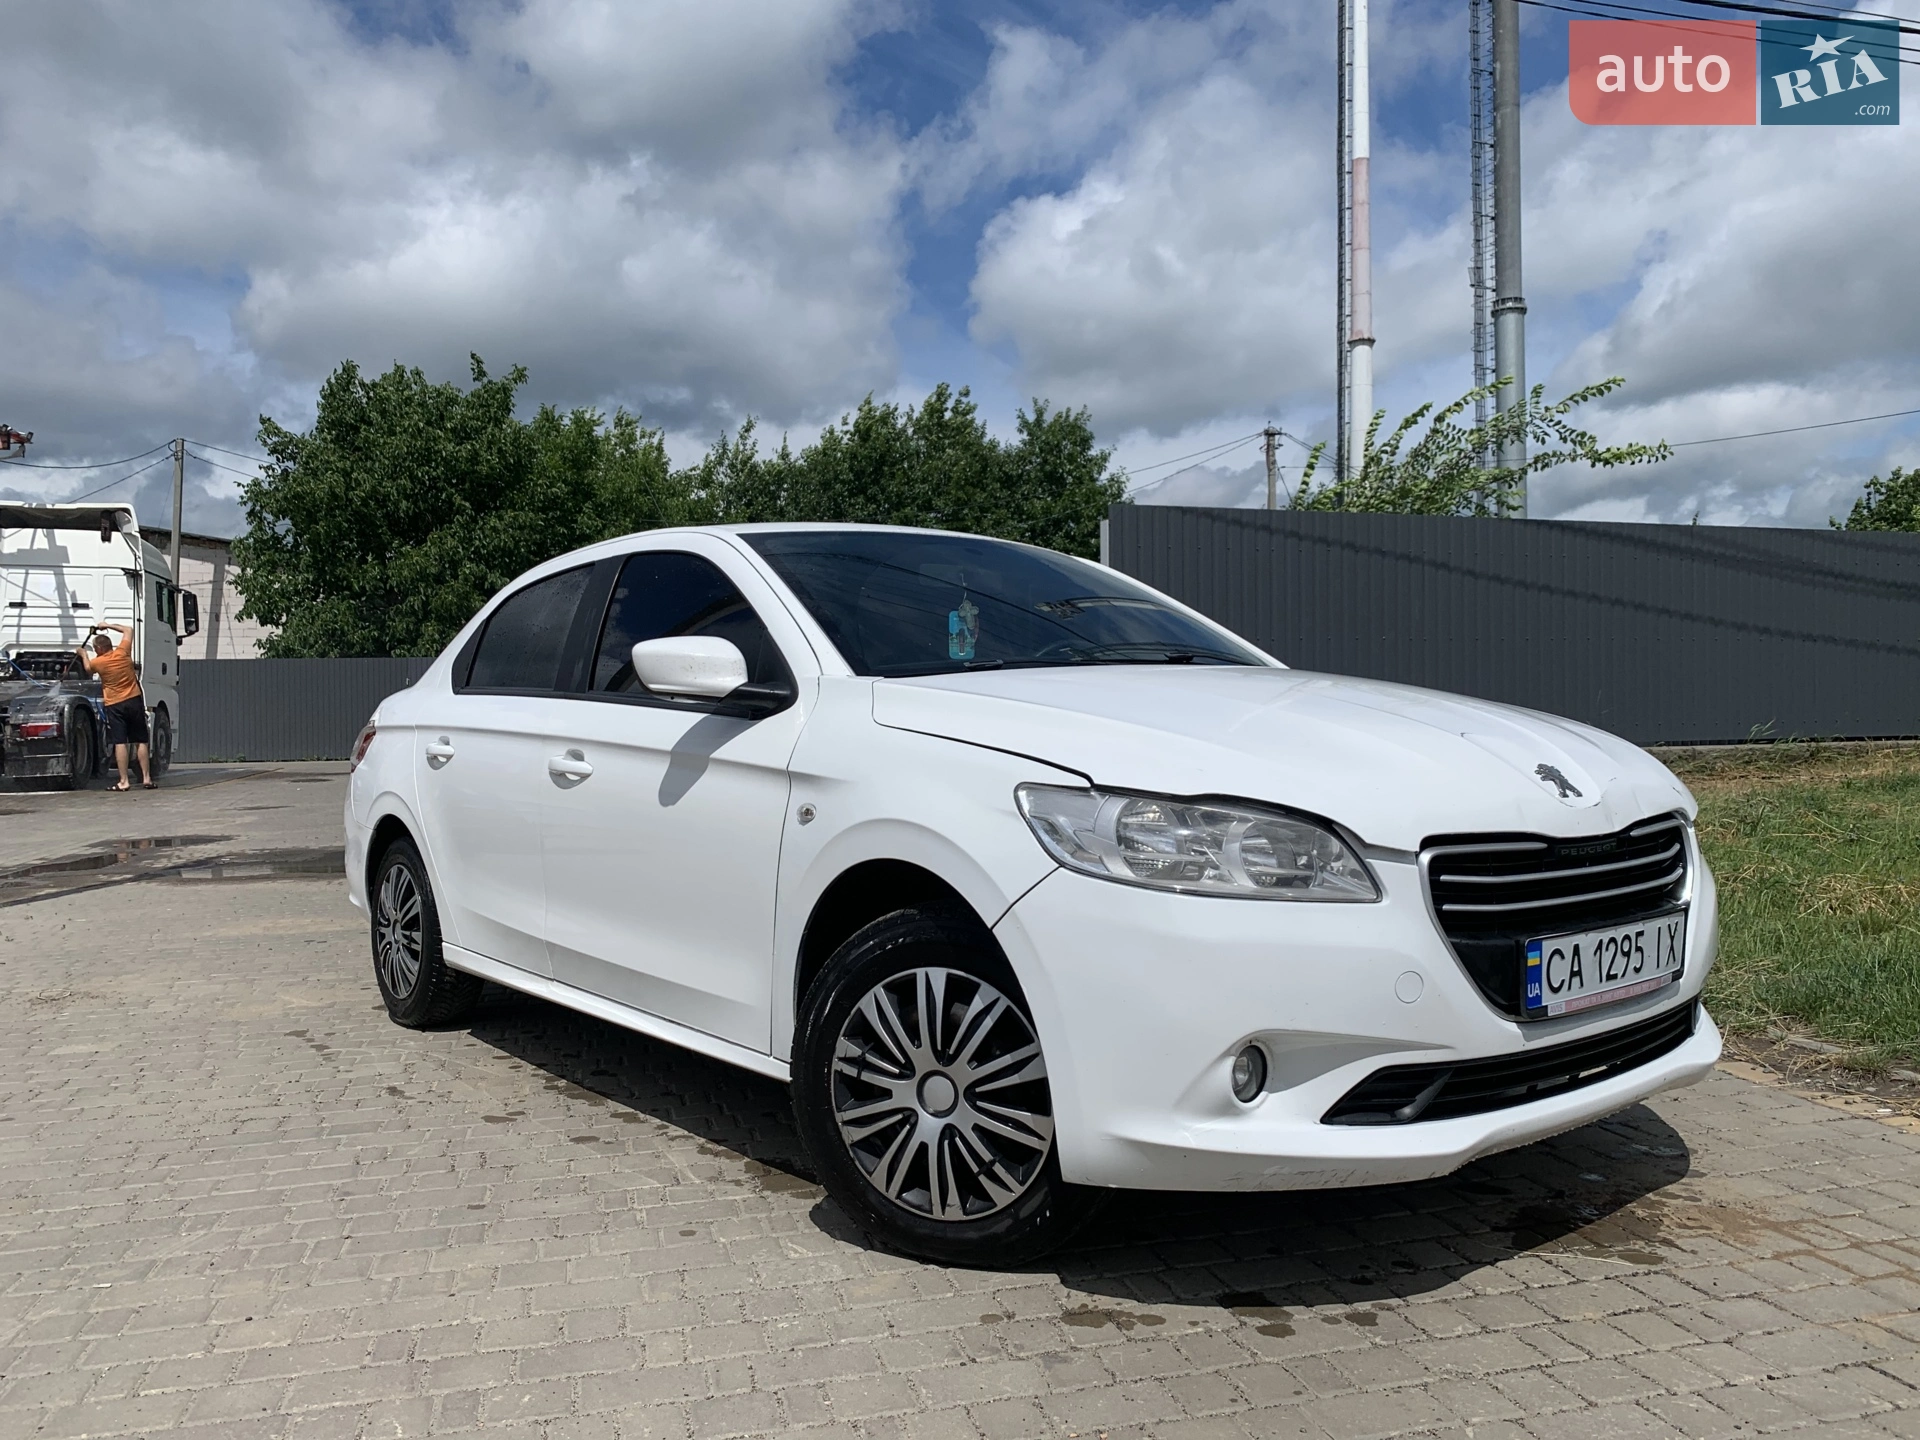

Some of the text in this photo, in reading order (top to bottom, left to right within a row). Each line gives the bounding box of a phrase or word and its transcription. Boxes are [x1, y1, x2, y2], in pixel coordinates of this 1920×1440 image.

[1561, 842, 1617, 856] PEUGEOT
[1546, 943, 1584, 994] CA
[1593, 930, 1645, 984] 1295
[1527, 982, 1541, 998] UA
